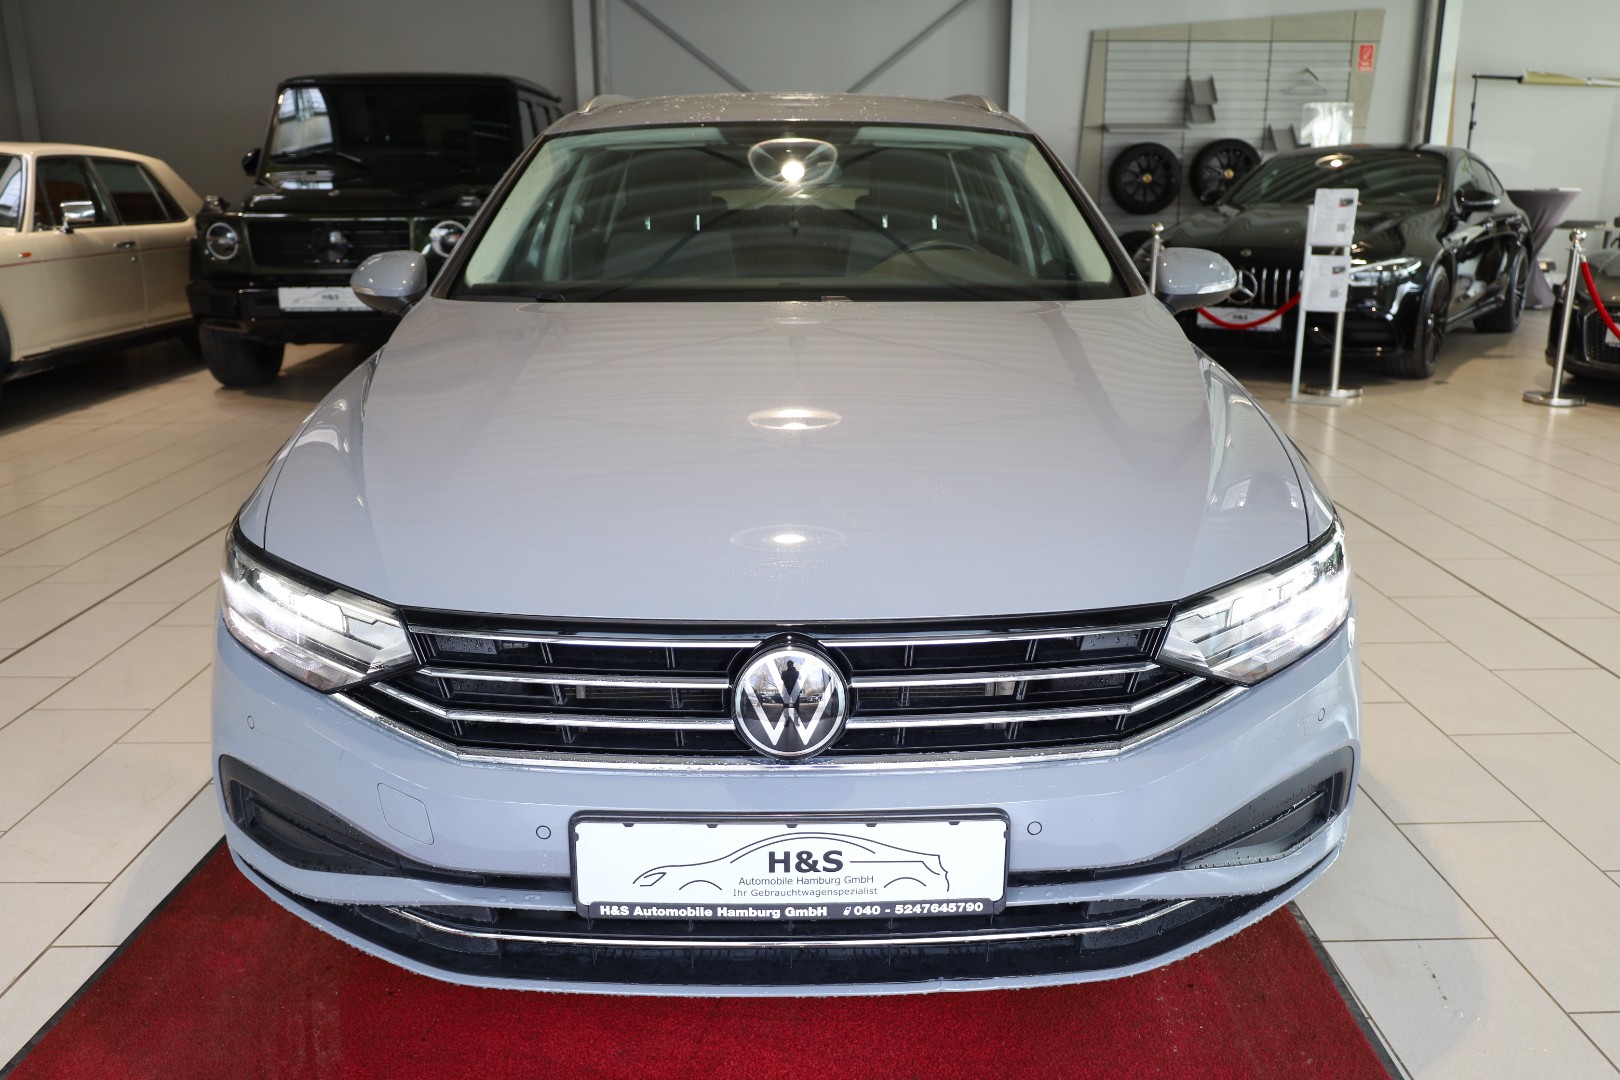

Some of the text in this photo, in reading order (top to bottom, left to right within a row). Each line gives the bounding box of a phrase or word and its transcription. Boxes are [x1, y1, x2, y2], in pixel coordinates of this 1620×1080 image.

[768, 850, 844, 874] H&S
[738, 875, 875, 888] Automobile Hamburg GmbH
[733, 887, 879, 899] Ihr Gebrauchtwagenspezialist
[600, 905, 828, 919] H&S Automobile Hamburg GmbH
[853, 904, 881, 916] 040
[895, 902, 984, 914] 5247645790
